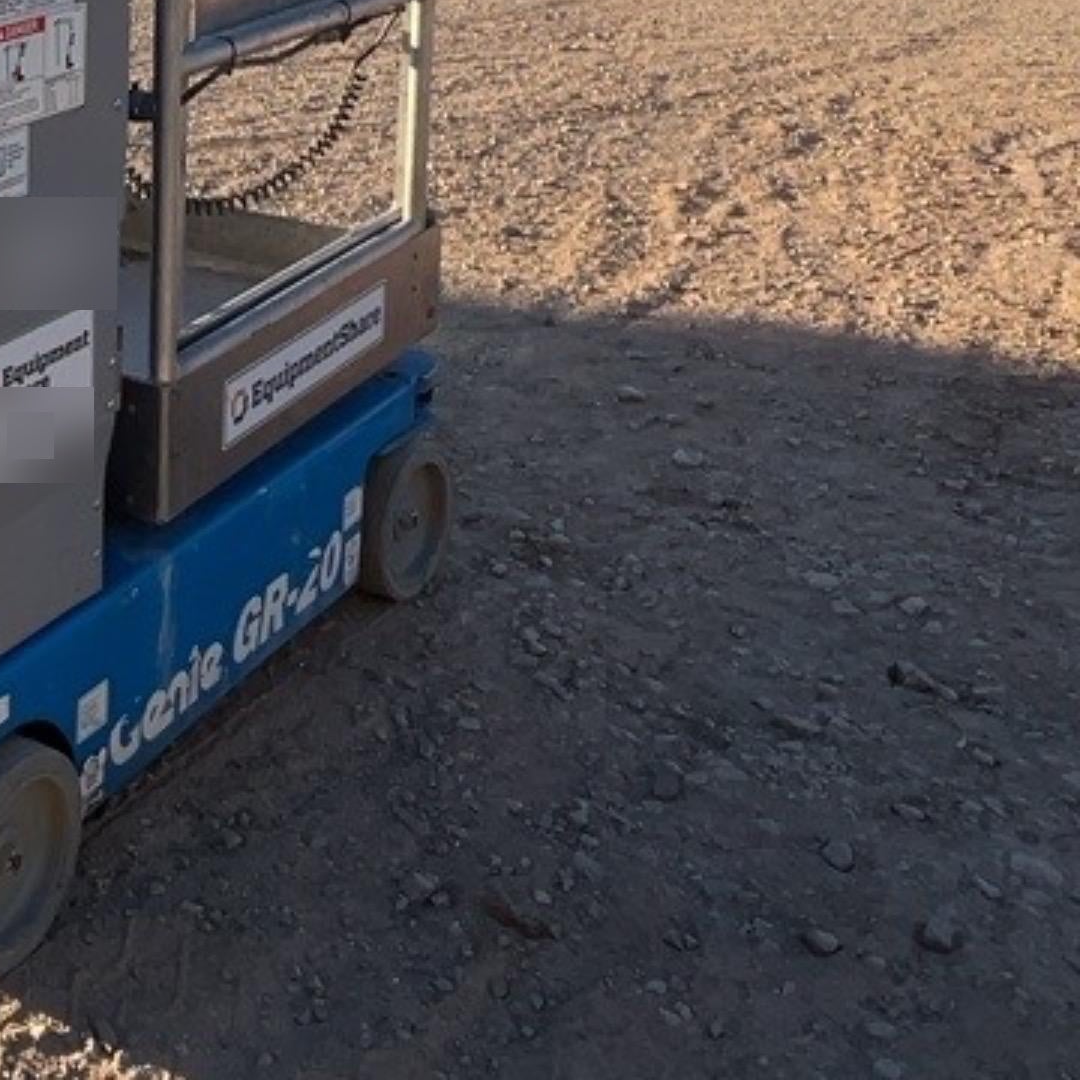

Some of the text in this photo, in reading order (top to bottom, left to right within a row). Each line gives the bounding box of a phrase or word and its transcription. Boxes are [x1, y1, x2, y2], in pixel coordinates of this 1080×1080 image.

[2, 328, 89, 387] Equipment
[251, 305, 382, 409] EquipmentShare
[110, 529, 343, 766] Genie GR-20
